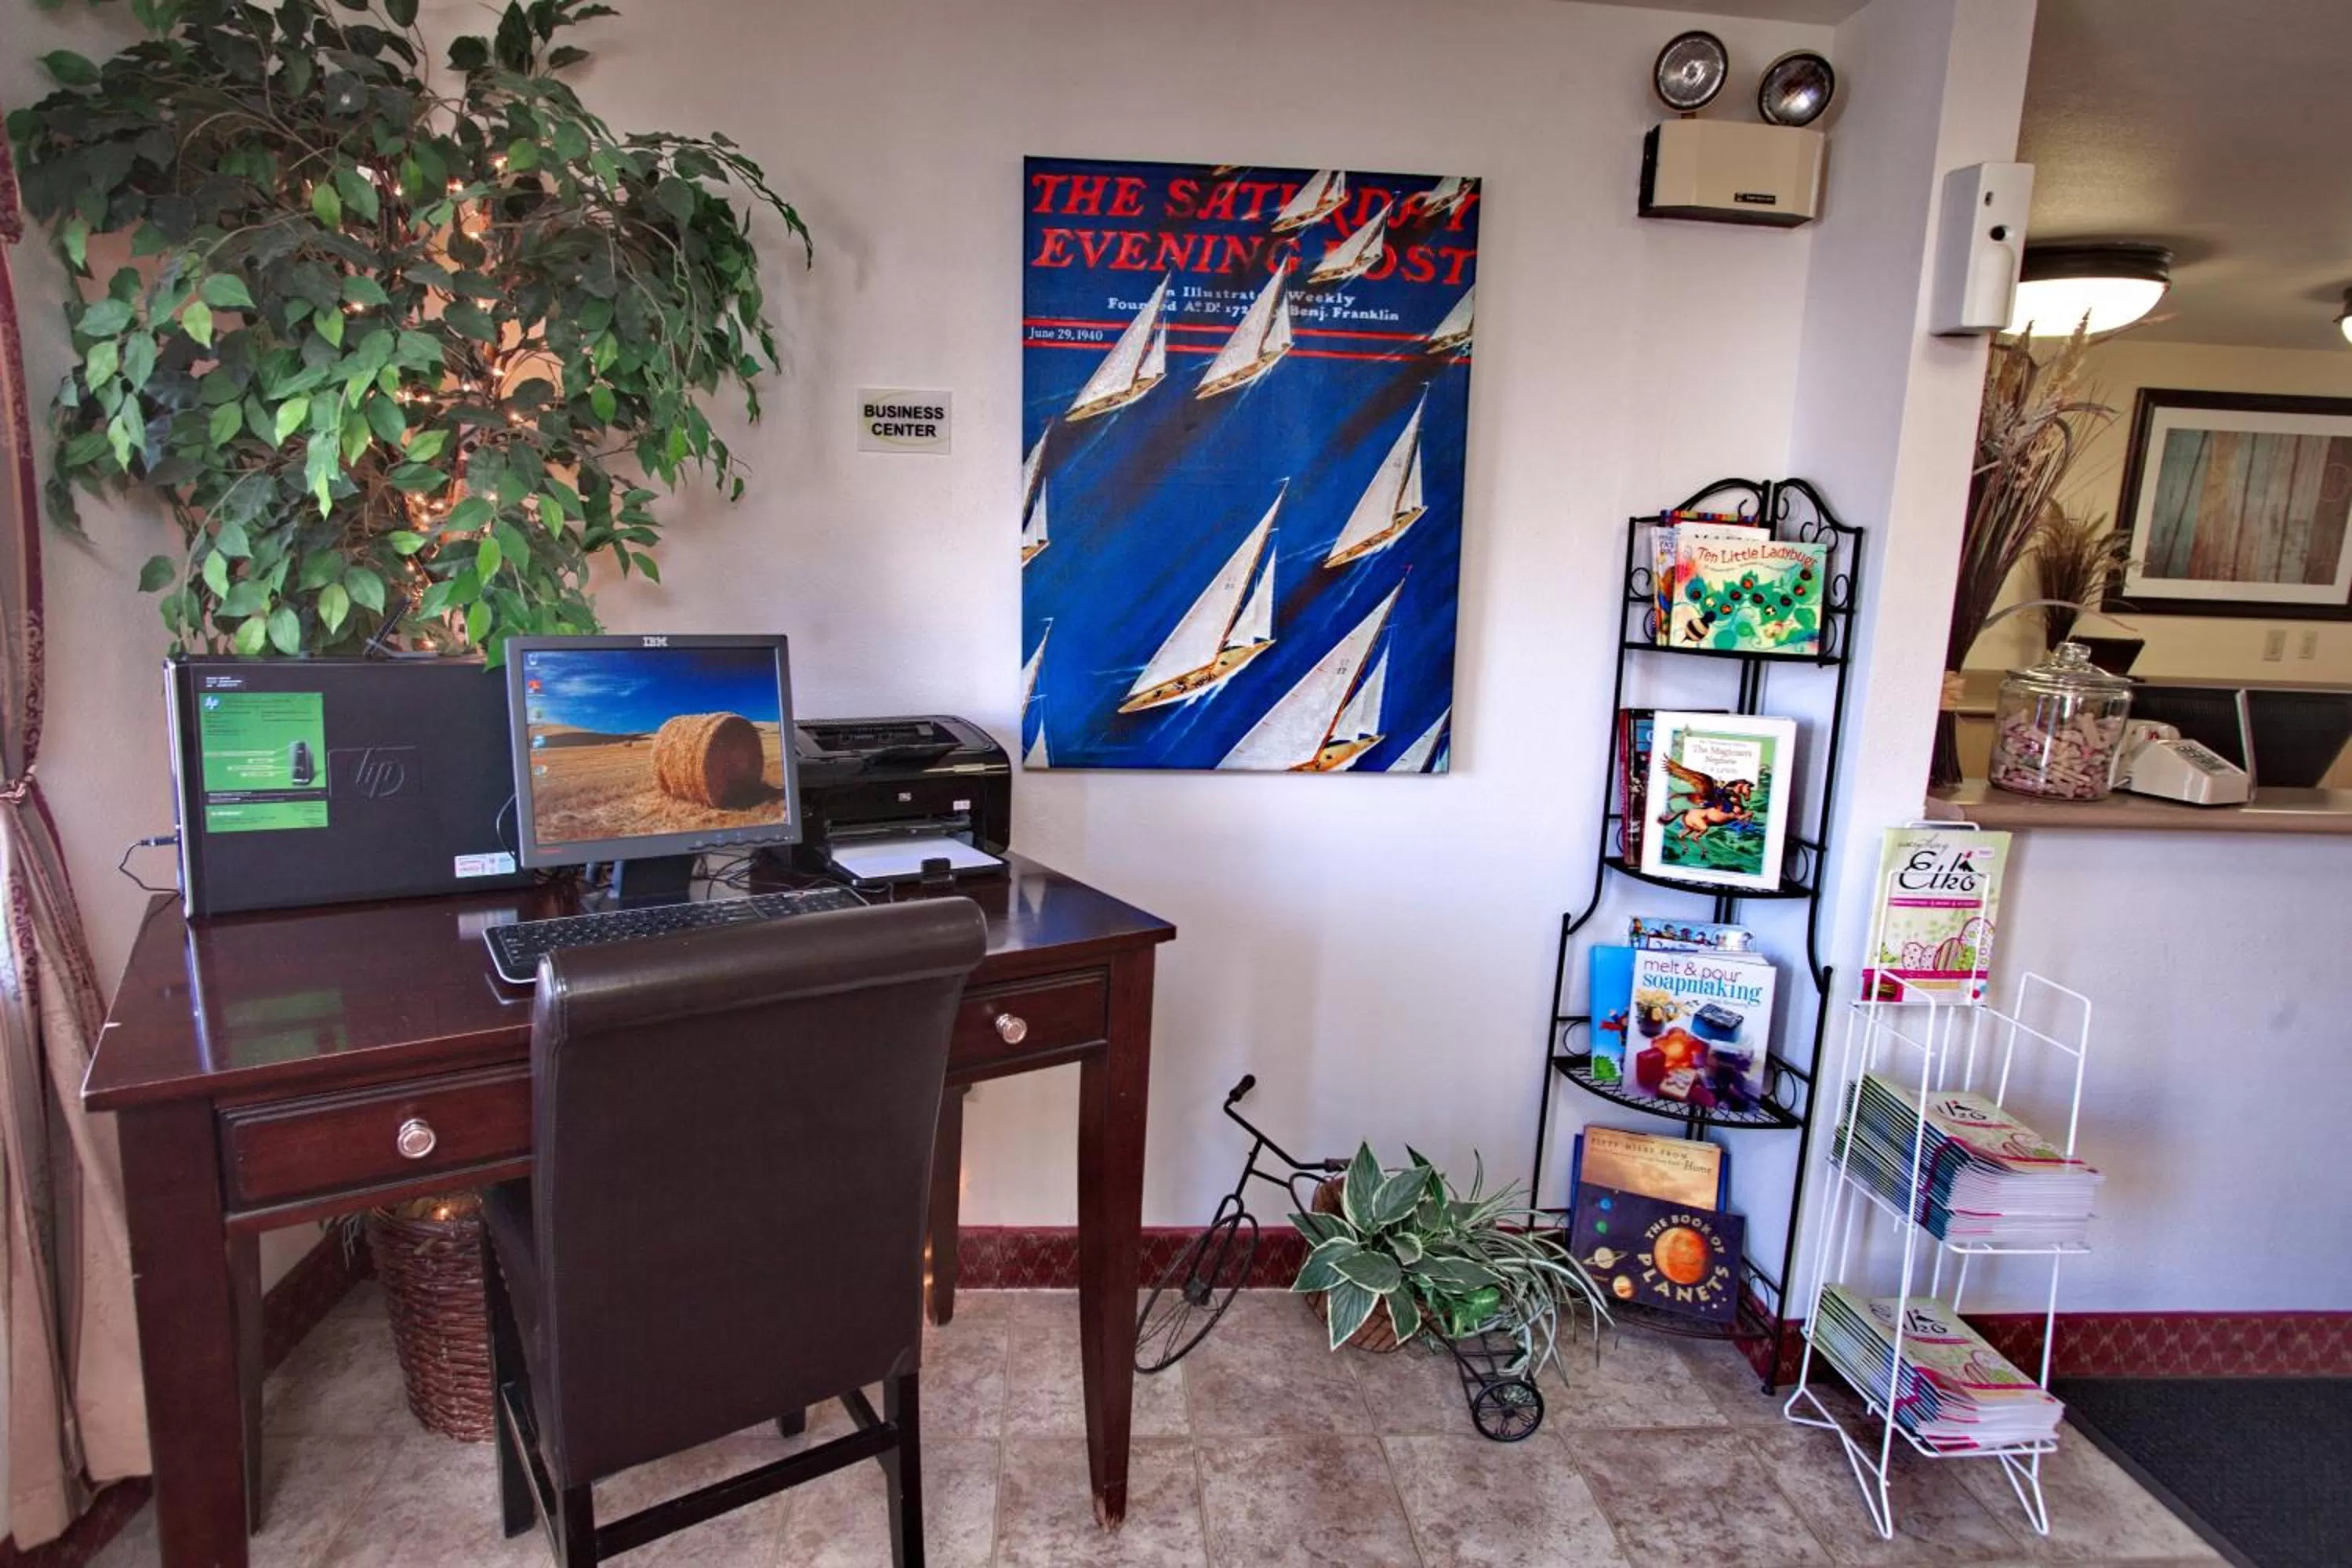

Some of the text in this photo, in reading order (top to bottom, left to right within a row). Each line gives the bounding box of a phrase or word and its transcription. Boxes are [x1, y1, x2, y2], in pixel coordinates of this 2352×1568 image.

[1032, 173, 1148, 217] THE
[1030, 227, 1477, 285] EVENING OST
[1108, 297, 1177, 311] Founed
[1225, 307, 1250, 318] 172
[1288, 304, 1329, 321] Benj.
[1333, 307, 1399, 321] Franklin
[1183, 286, 1257, 301] Illustrat
[1288, 290, 1356, 308] Weekly
[1028, 326, 1104, 341] June 29, 1940
[864, 404, 945, 419] BUSINESS
[871, 423, 936, 437] CENTER
[1697, 546, 1719, 563] Ten
[1721, 546, 1759, 564] Little
[643, 636, 668, 647] IBM
[1898, 850, 1977, 891] Elko
[1644, 959, 1742, 983] melt & pour
[1642, 971, 1763, 1006] soapmaking
[1645, 1214, 1726, 1254] THE BOOK OF
[1637, 1254, 1730, 1304] PLANETS
